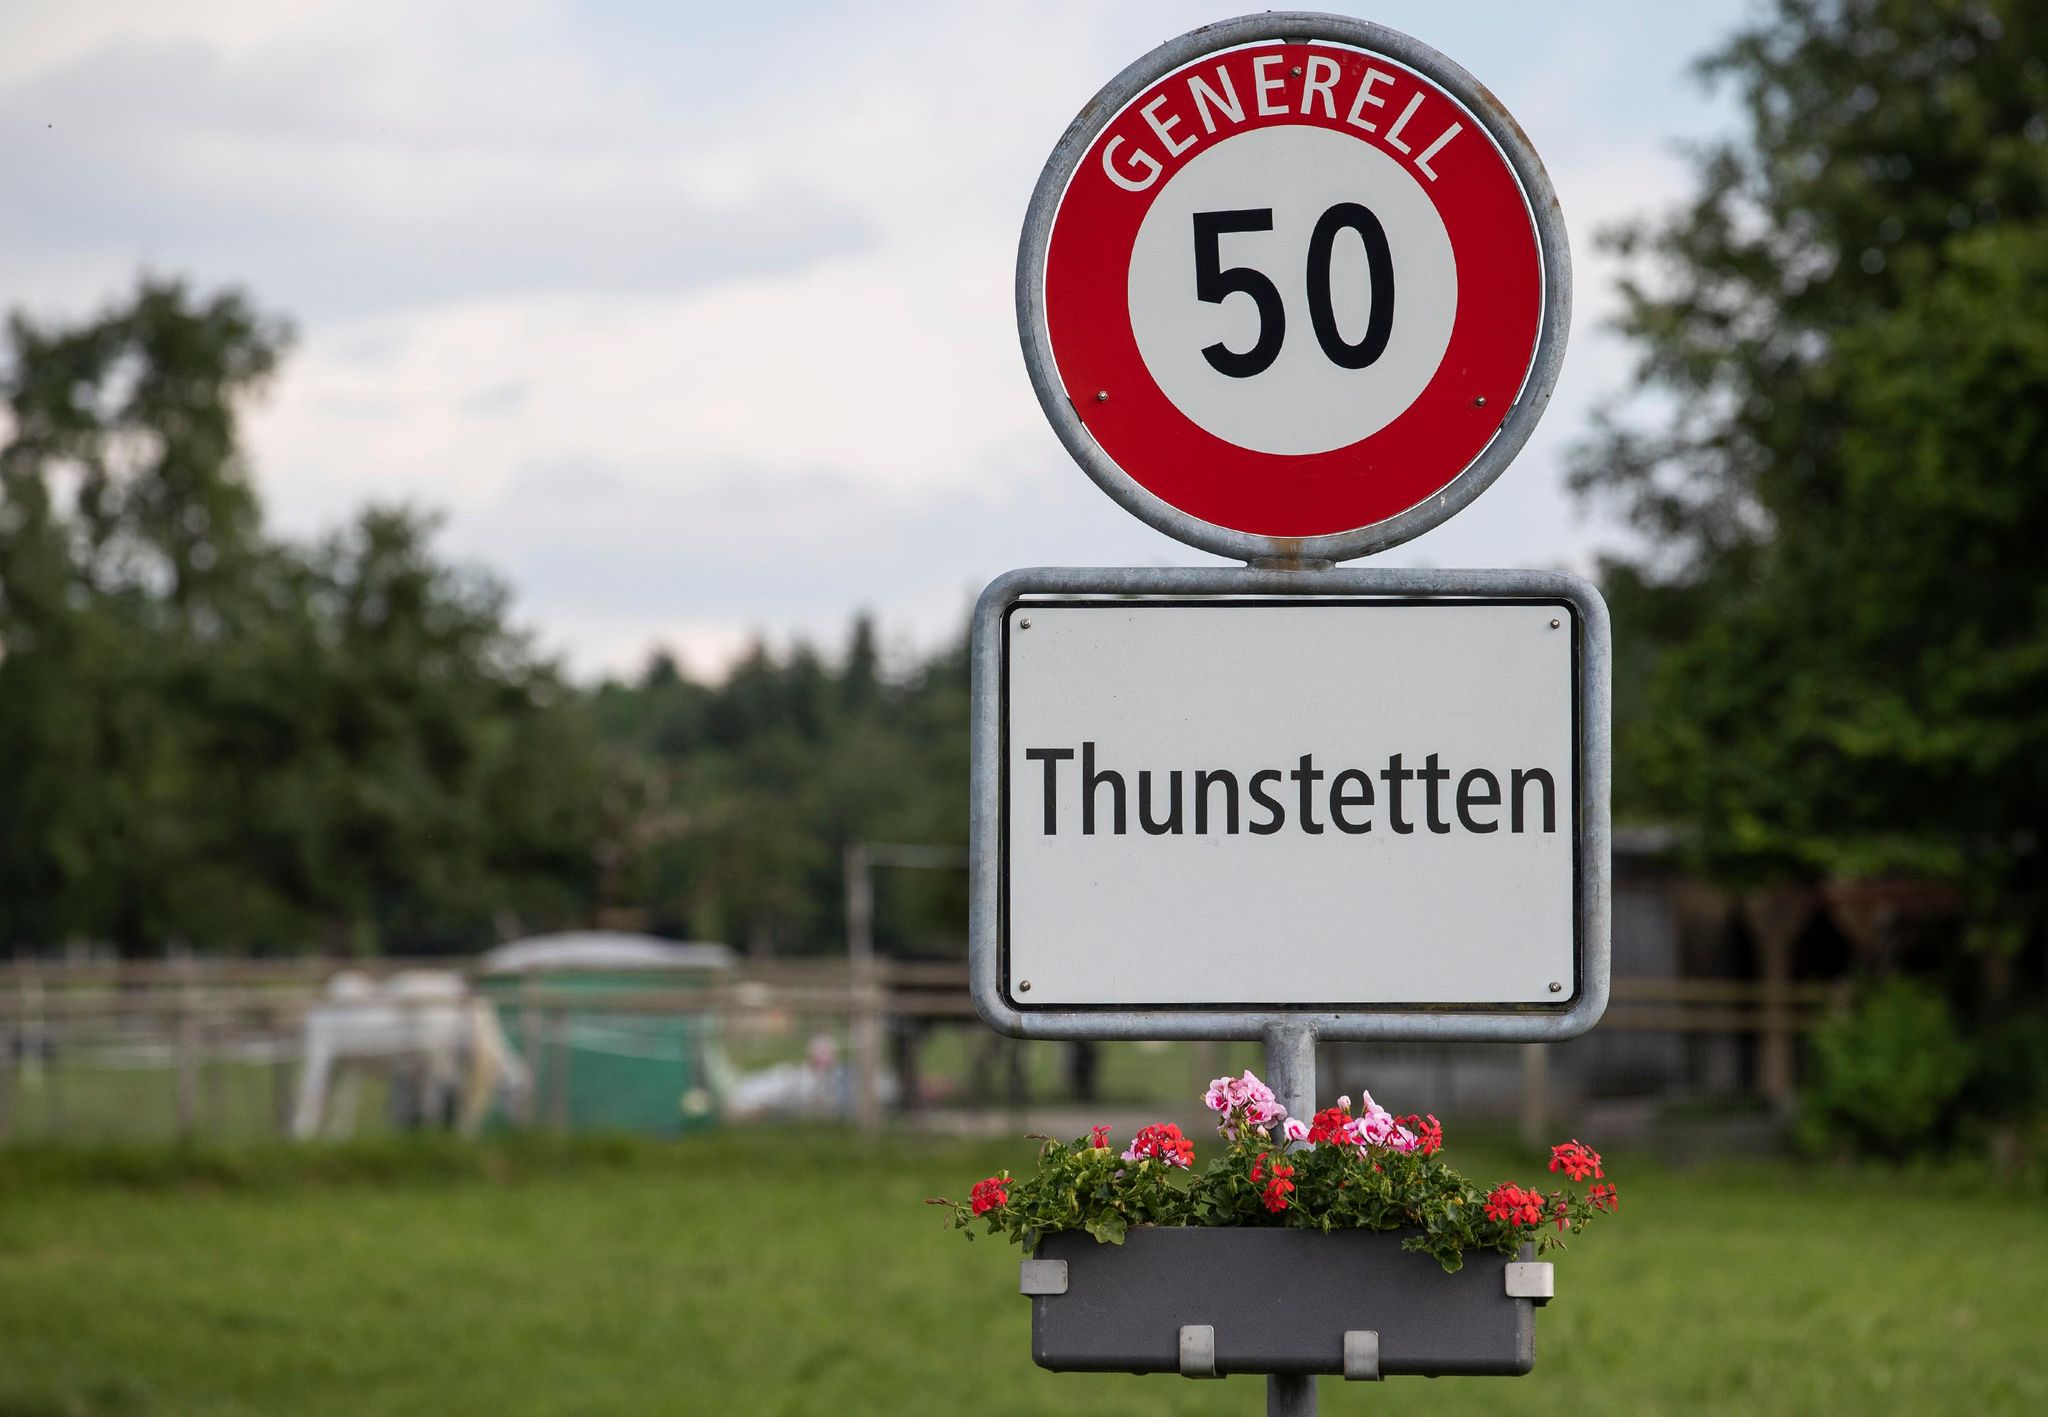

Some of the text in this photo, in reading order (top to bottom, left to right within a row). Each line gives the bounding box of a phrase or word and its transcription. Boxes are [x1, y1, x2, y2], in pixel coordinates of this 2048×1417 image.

[1102, 54, 1464, 192] GENERELL
[1192, 202, 1396, 379] 50
[1026, 742, 1556, 836] Thunstetten
